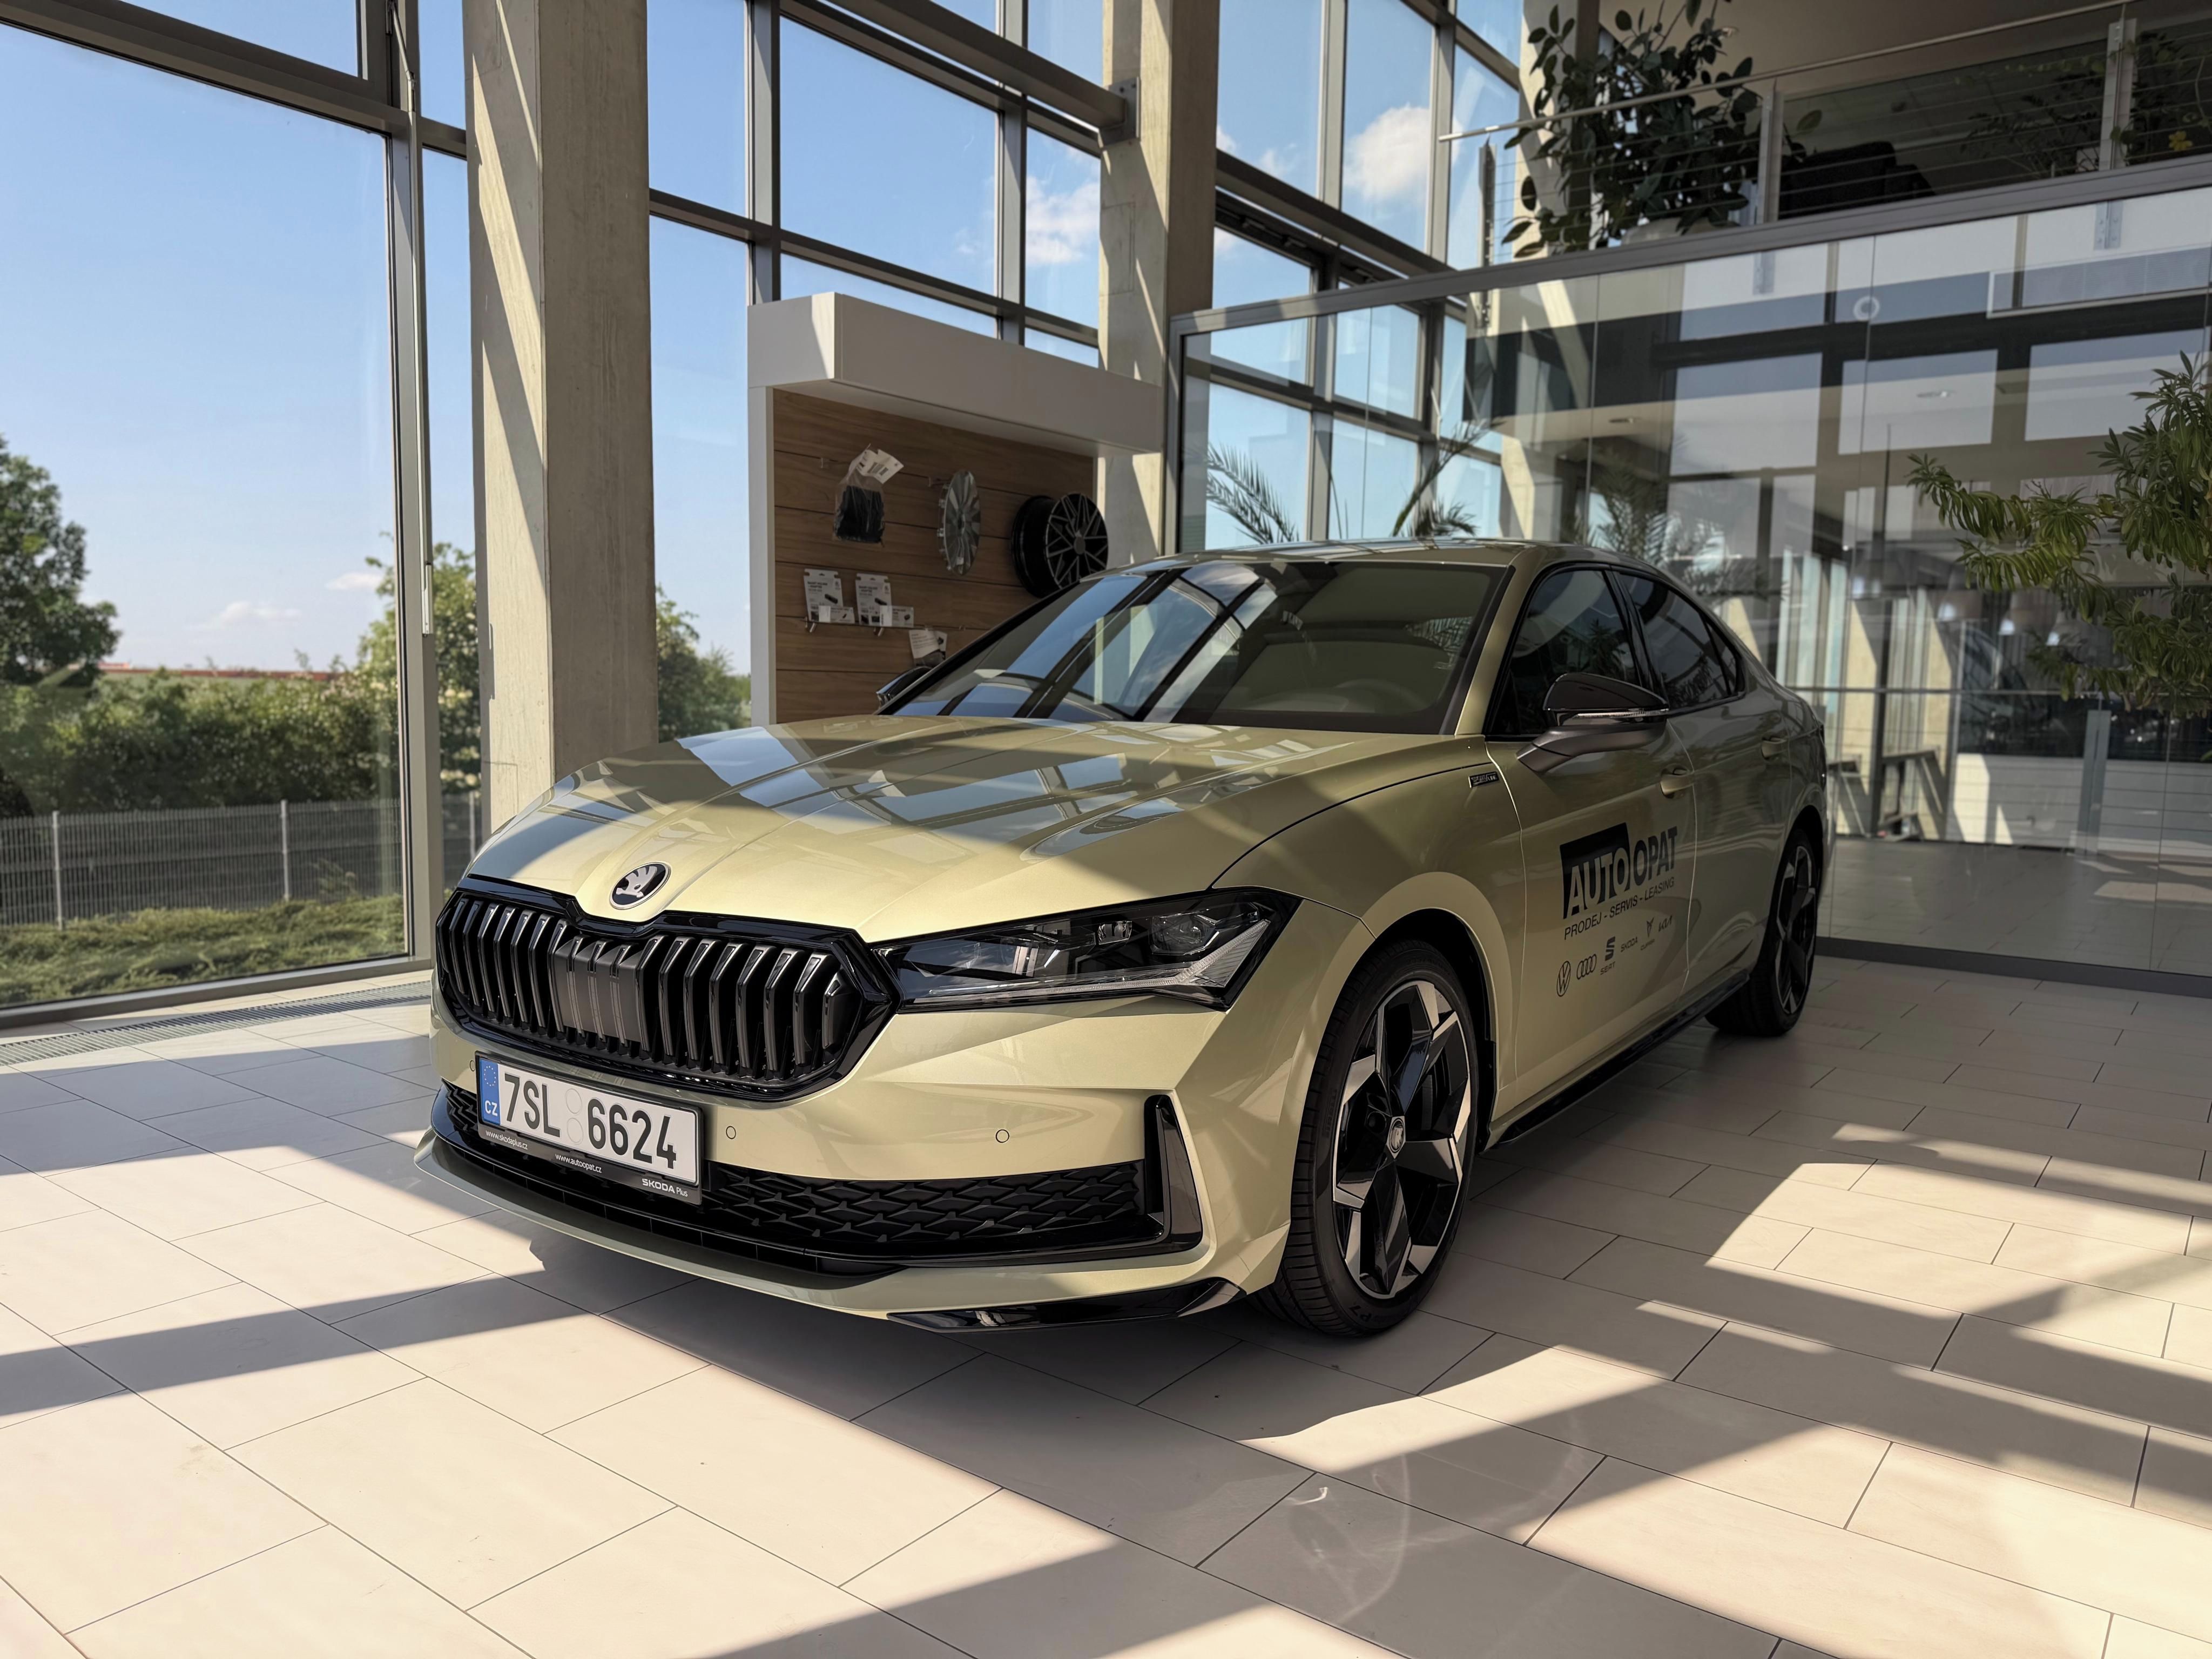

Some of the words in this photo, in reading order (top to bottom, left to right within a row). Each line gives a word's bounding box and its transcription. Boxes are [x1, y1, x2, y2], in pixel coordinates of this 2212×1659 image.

[1564, 914, 1602, 940] PRODEJ
[1609, 895, 1637, 918] SERVIS
[1644, 876, 1674, 901] LEASING
[1600, 961, 1615, 975] SEAT
[484, 1100, 498, 1116] CZ
[504, 1073, 561, 1138] 7SL
[588, 1097, 677, 1169] 6624
[485, 1130, 528, 1150] www.skodaplus.cz
[555, 1154, 602, 1173] www.autoopat.cz
[676, 1187, 688, 1197] Plus
